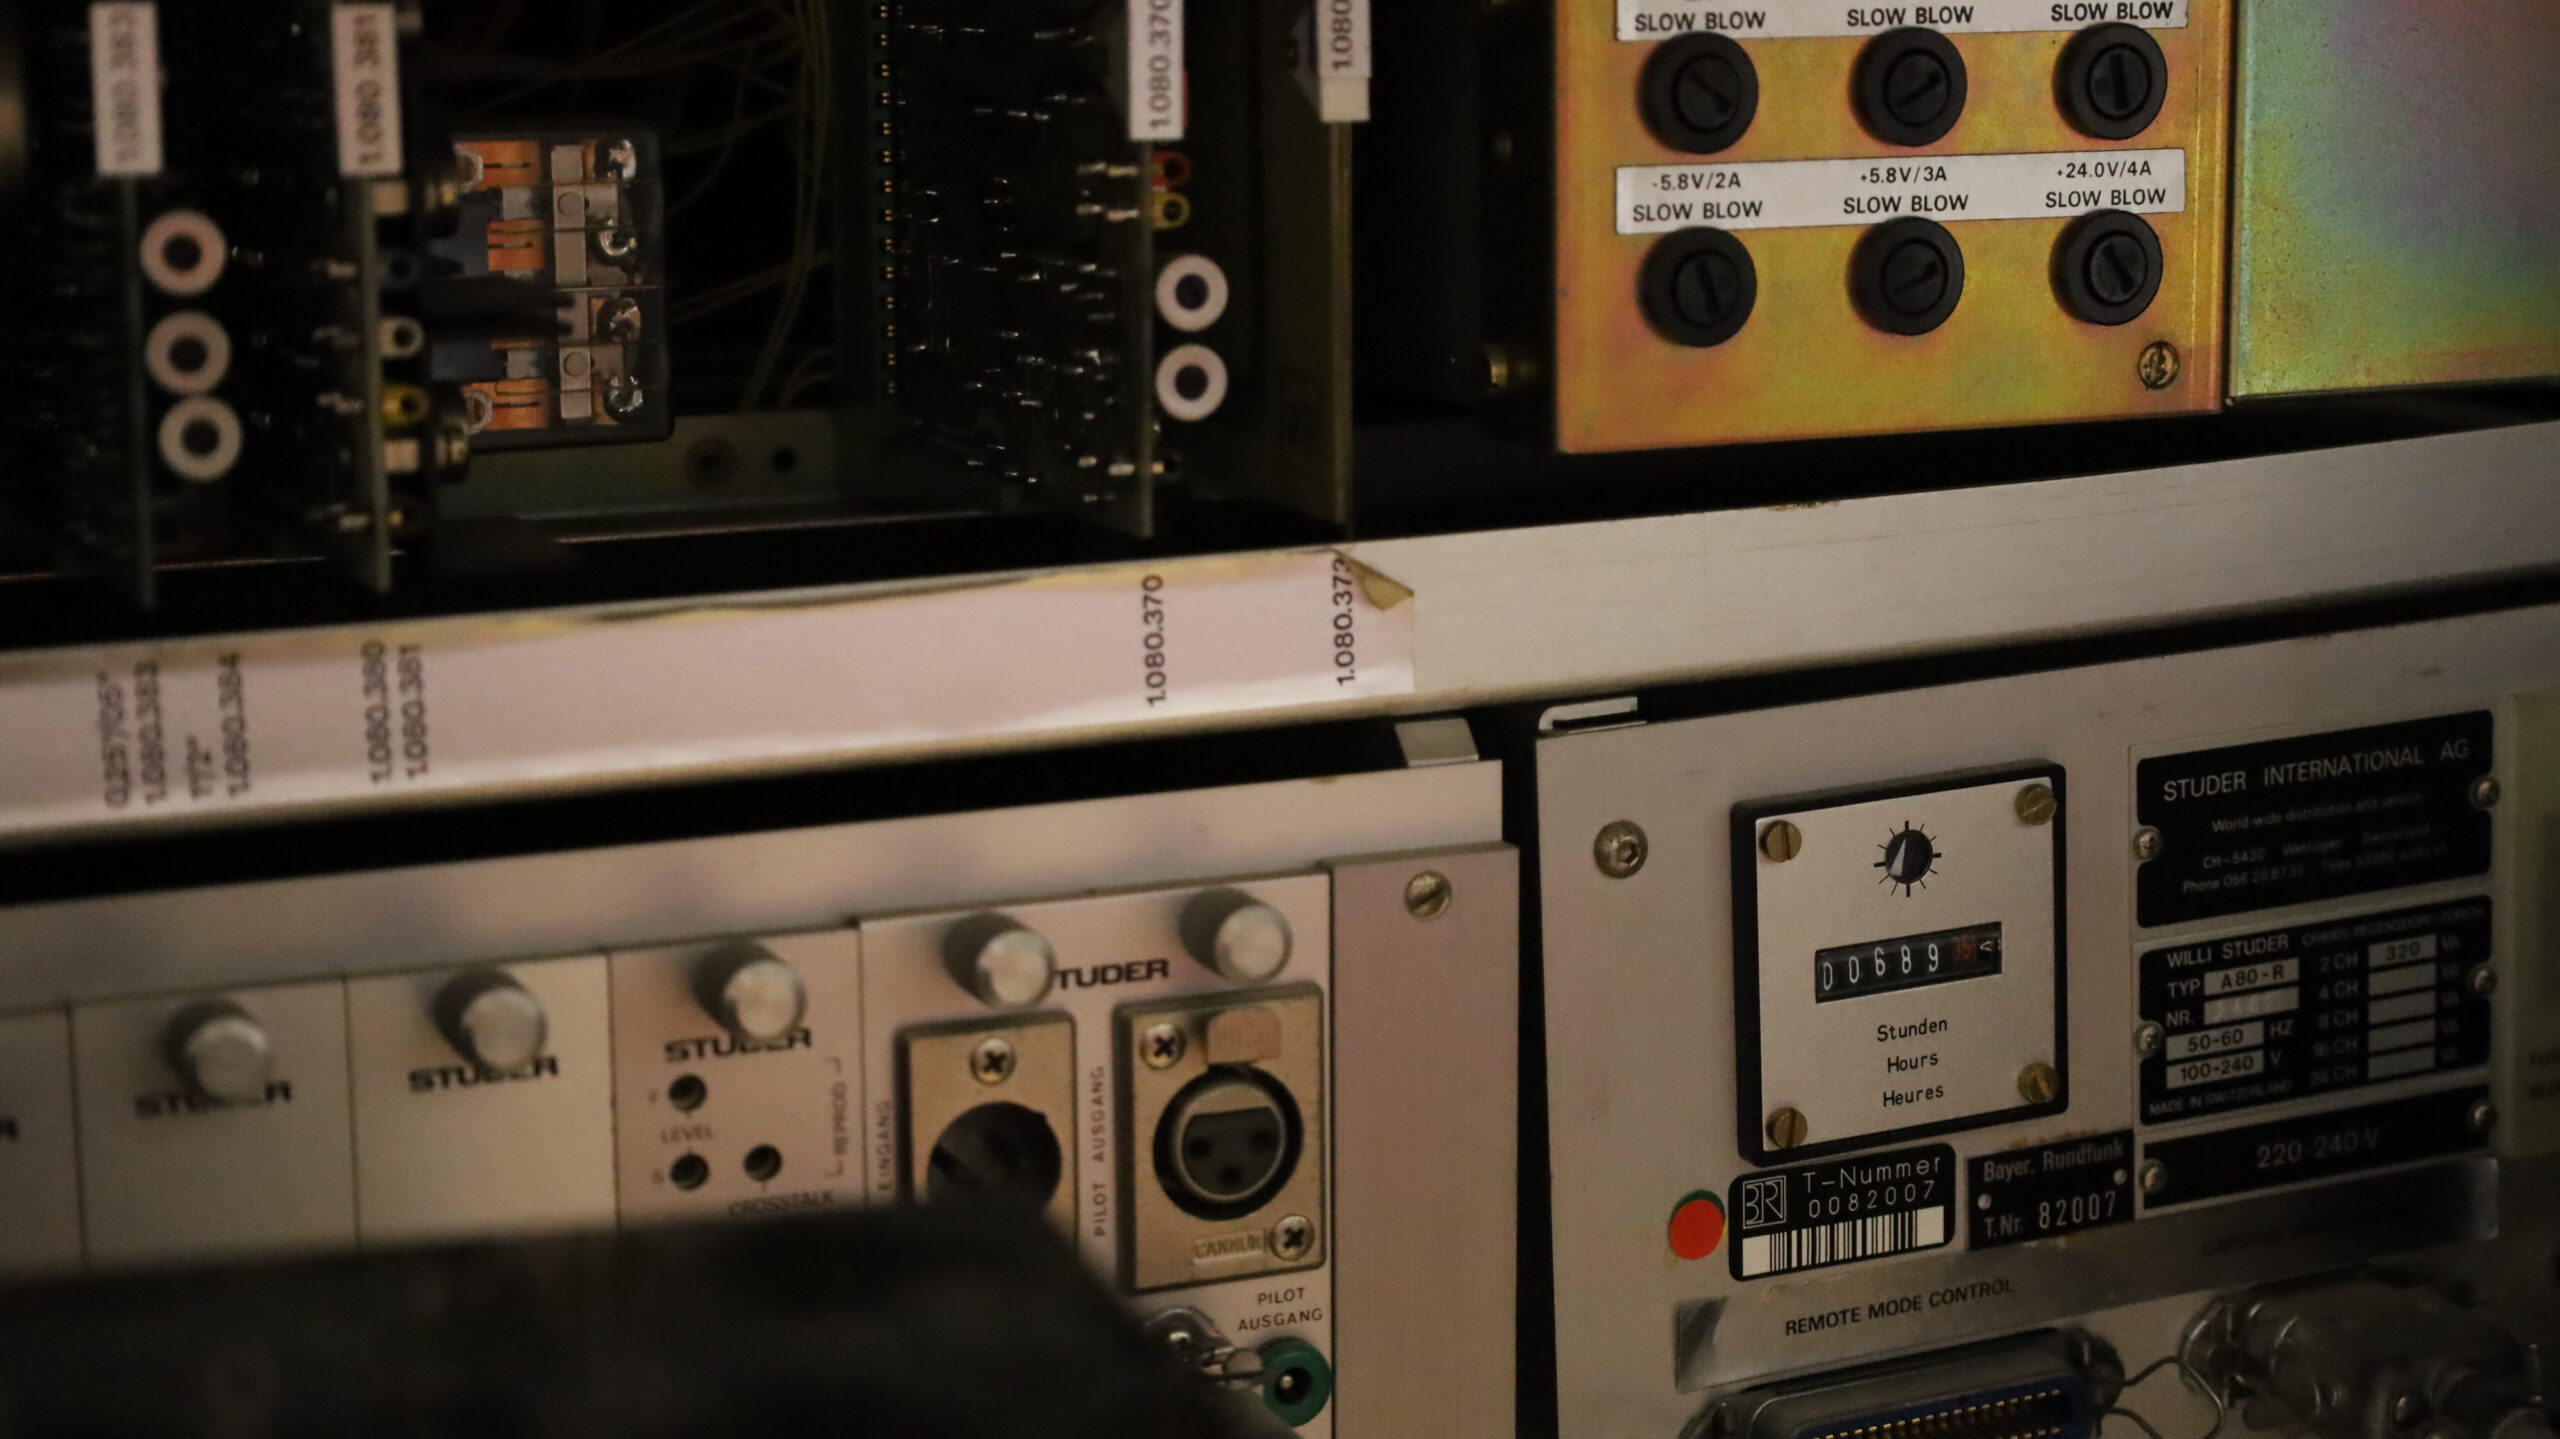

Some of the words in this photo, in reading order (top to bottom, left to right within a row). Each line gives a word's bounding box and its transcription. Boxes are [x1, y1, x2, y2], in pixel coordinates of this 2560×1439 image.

[1635, 13, 1696, 32] SLOW
[1705, 11, 1766, 30] BLOW
[1847, 8, 1906, 27] SLOW
[1915, 6, 1974, 25] BLOW
[2051, 3, 2108, 22] SLOW
[2117, 1, 2174, 20] BLOW
[1860, 166, 1947, 184] +5.8V/3A
[2057, 160, 2152, 179] +24.0V/4A
[1633, 203, 1693, 222] SLOW
[1703, 200, 1763, 219] BLOW
[1843, 196, 1902, 215] SLOW
[1911, 194, 1969, 212] BLOW
[2045, 190, 2102, 208] SLOW
[2110, 188, 2166, 206] BLOW
[1141, 574, 1166, 707] 1.080.370
[2163, 770, 2248, 801] STUDER
[2264, 747, 2425, 787] INTERNATIONAL
[2440, 738, 2470, 761] AG
[2167, 947, 2212, 969] WILLI
[2221, 934, 2290, 960] STUDER
[2334, 952, 2359, 969] CH
[2385, 941, 2421, 961] 320
[1053, 958, 1170, 990] TUDER
[2168, 979, 2201, 999] TYP
[2220, 964, 2285, 990] A80-R
[2334, 981, 2359, 997] CH
[1876, 1018, 1949, 1043] Stunden
[2334, 1009, 2359, 1026] CH
[2187, 1028, 2244, 1053] 50-60
[2269, 1020, 2294, 1038] HZ
[1886, 1052, 1940, 1075] Hours
[2180, 1055, 2254, 1082] 100-240
[2268, 1051, 2282, 1067] V
[1882, 1084, 1945, 1108] Heures
[1090, 1065, 1106, 1164] AUSGANG
[1983, 1159, 2035, 1183] Bayer.
[2042, 1138, 2124, 1171] Rundfunk
[1803, 1157, 1941, 1194] T-Nummer
[1092, 1182, 1107, 1238] PILOT
[1808, 1179, 1936, 1219] 0082007
[2038, 1190, 2117, 1230] 82007
[1257, 1286, 1305, 1305] PILOT
[1785, 1306, 1861, 1337] REMOTE
[1867, 1295, 1923, 1321] MODE
[1929, 1278, 2014, 1309] CONTROL
[1238, 1307, 1324, 1332] AUSGANG
